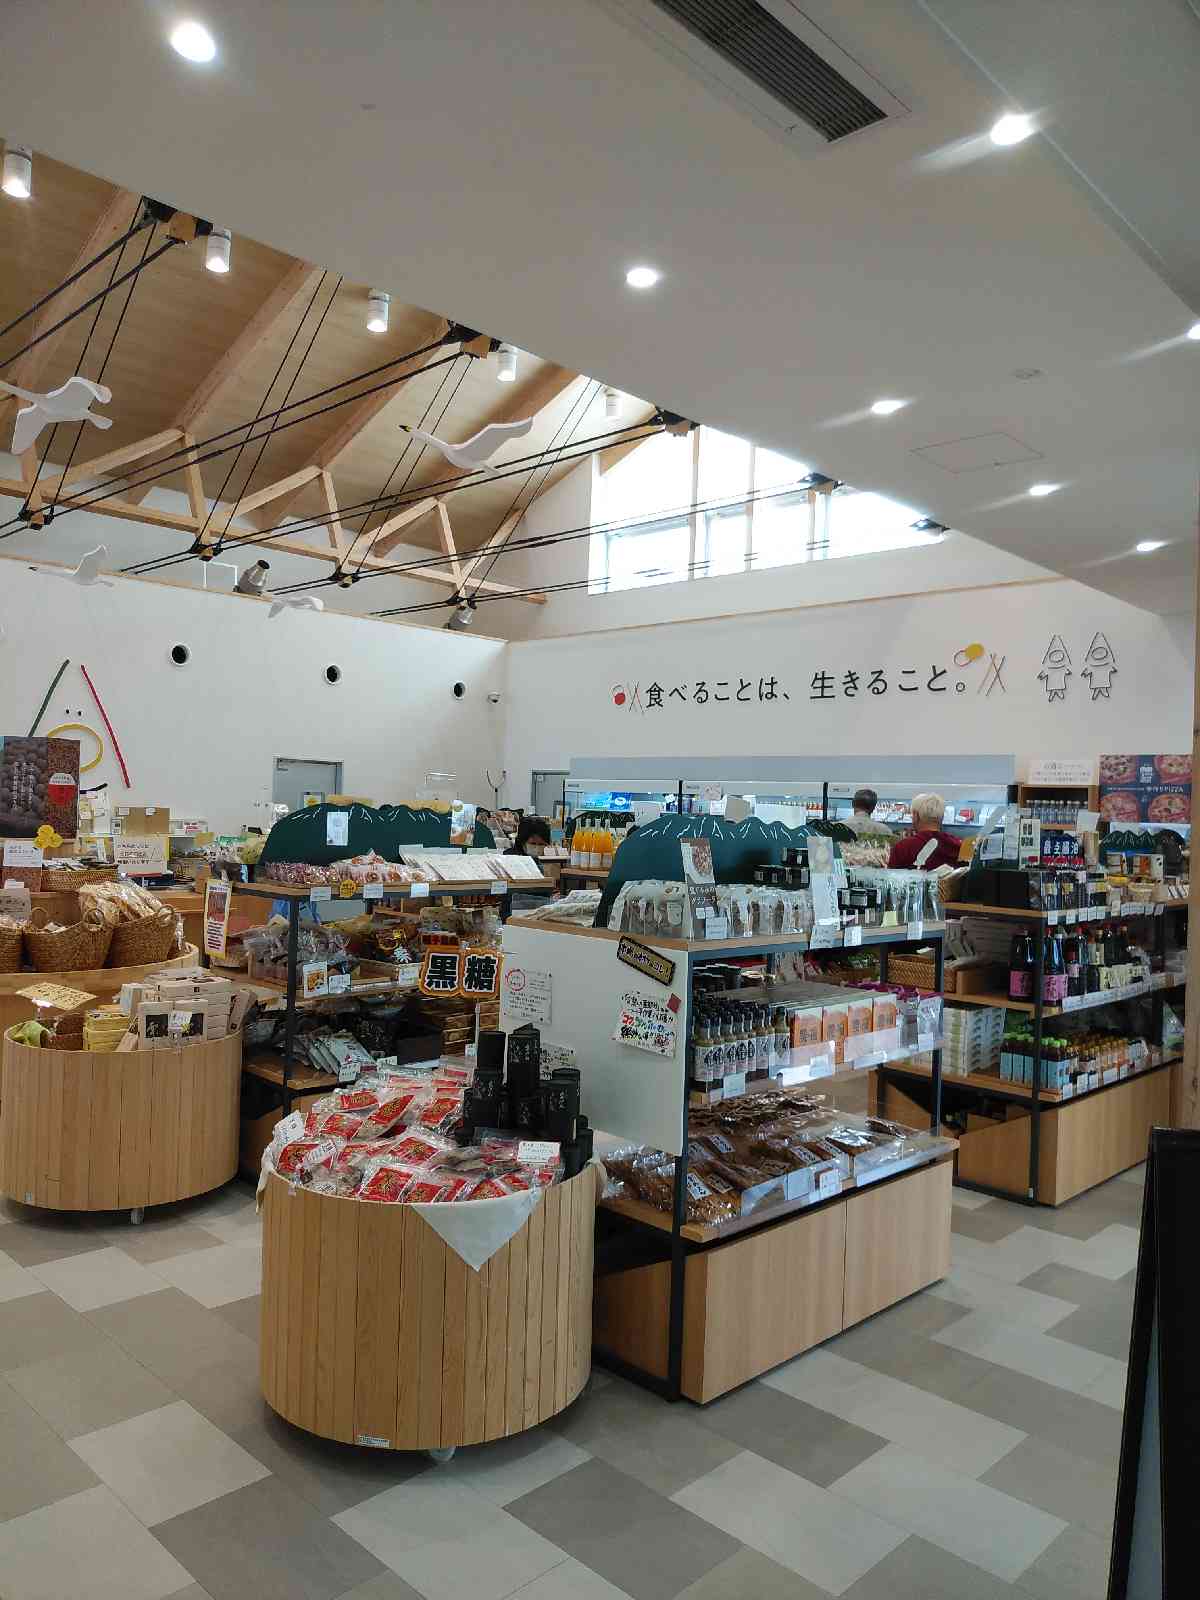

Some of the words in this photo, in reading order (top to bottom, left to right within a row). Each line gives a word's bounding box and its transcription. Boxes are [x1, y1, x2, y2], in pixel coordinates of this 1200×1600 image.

[646, 665, 966, 708] 食べることは、生きること。
[426, 953, 498, 992] 黒糖
